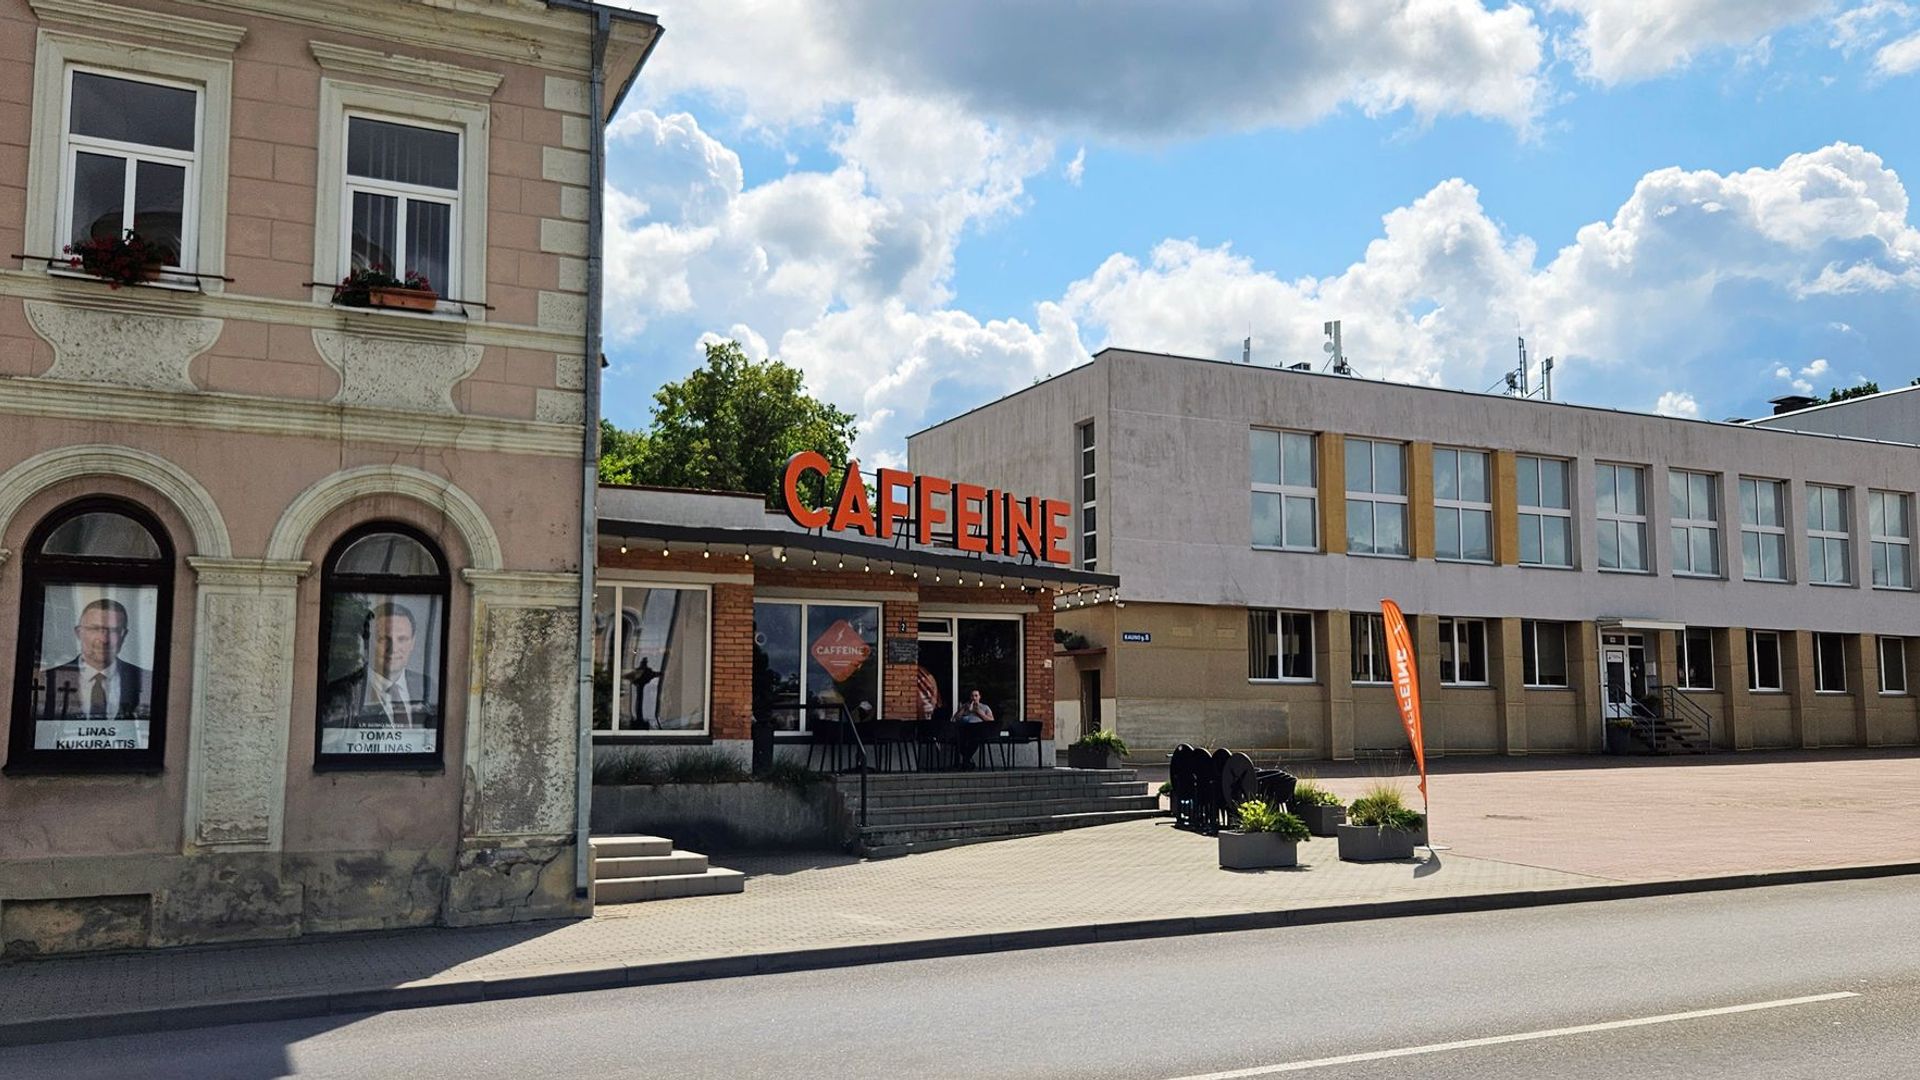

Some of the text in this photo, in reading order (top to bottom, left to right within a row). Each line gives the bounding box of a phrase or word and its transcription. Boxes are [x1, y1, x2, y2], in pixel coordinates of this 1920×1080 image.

[782, 450, 1071, 564] CAFFEINE
[816, 645, 865, 656] CAFFEINE
[78, 727, 116, 737] LINAS
[360, 731, 402, 741] TOMAS
[56, 739, 136, 749] KUKURAITIS
[347, 743, 412, 753] TOMILINAS
